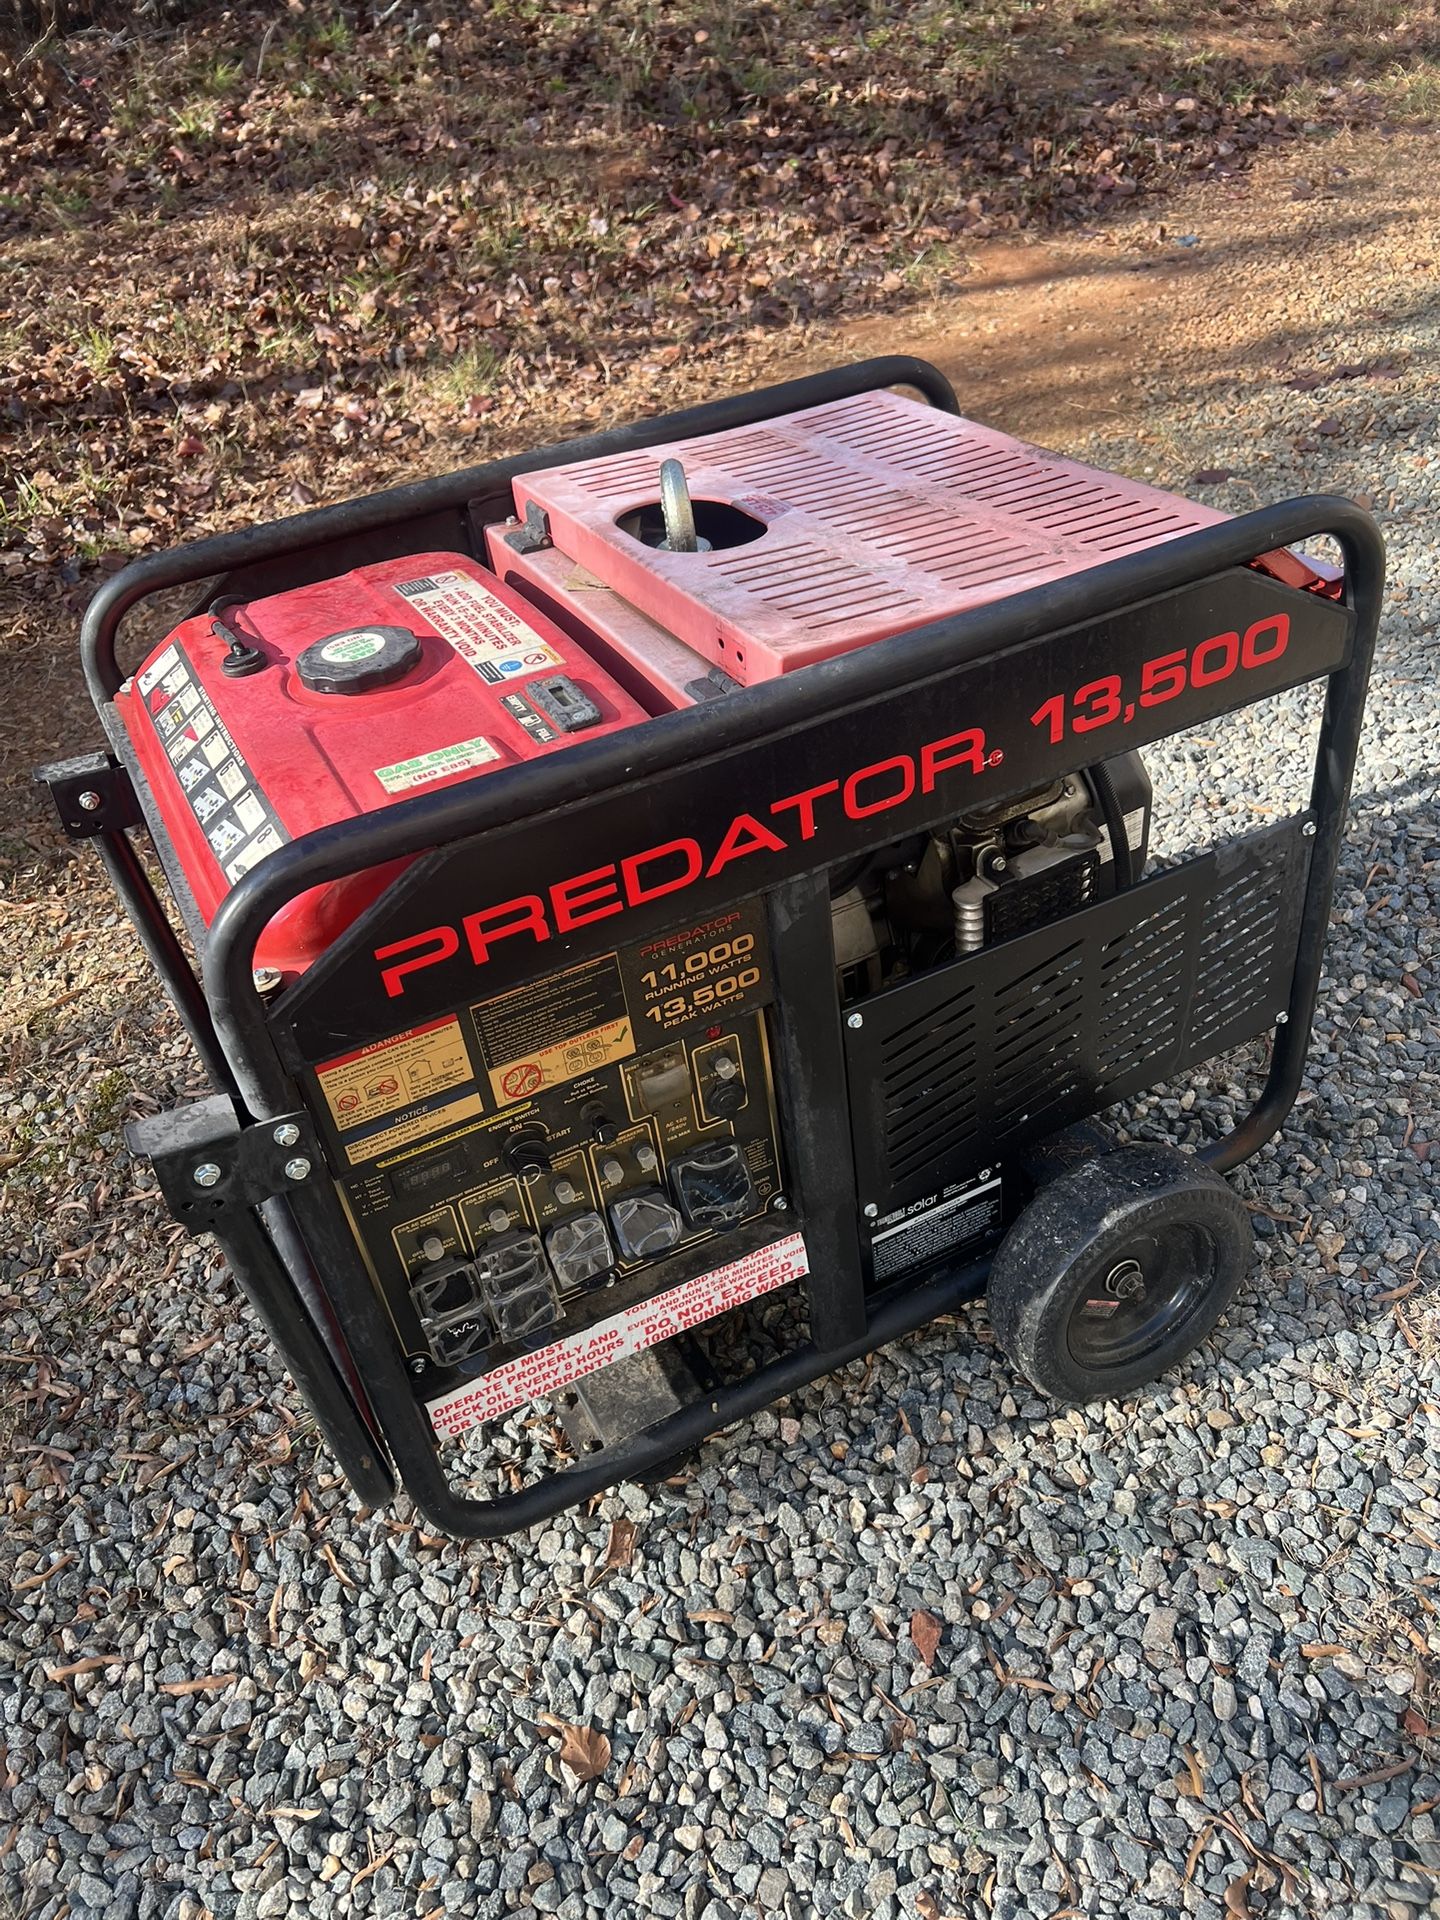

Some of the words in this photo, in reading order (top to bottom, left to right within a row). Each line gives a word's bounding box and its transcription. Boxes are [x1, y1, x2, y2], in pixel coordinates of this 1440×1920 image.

[412, 598, 424, 608] OR
[421, 607, 462, 640] WARRANTY
[457, 637, 477, 657] VOID
[456, 589, 472, 602] ADD
[468, 599, 483, 614] FUEL
[482, 612, 522, 647] STABILIZER
[481, 594, 499, 609] YOU
[499, 605, 521, 627] MUST:
[455, 617, 485, 645] MONTHS
[474, 617, 507, 650] MINUTES
[1030, 613, 1291, 744] 13,500
[198, 685, 217, 716] STARTING
[214, 714, 246, 767] INSTRUCTIONS
[205, 732, 218, 747] 5
[536, 728, 552, 742] FULL
[219, 759, 234, 777] 6
[377, 758, 422, 779] GAS
[427, 738, 483, 762] ONLY
[412, 769, 437, 782] (NO
[441, 758, 472, 774] E85)
[257, 827, 273, 844] 8
[640, 912, 741, 957] PREDATOR
[652, 924, 733, 960] GENERATORS
[641, 933, 754, 988] 11,000
[645, 973, 705, 1001] RUNNING
[708, 953, 752, 976] WATTS
[645, 967, 760, 1022] 13,500
[663, 1011, 698, 1029] PEAK
[702, 992, 744, 1014] WATTS
[368, 1029, 414, 1051] DANGER
[538, 1047, 554, 1057] USE
[554, 1042, 567, 1051] TOP
[569, 1029, 598, 1045] OUTLETS
[599, 1021, 618, 1033] FIRST
[573, 1077, 595, 1089] CHOKE
[347, 1131, 387, 1151] DISCONNECT
[388, 1118, 419, 1134] POWERED
[419, 1107, 446, 1121] DEVICES
[393, 1104, 428, 1124] NOTICE
[488, 1119, 514, 1133] ENGINE
[514, 1107, 540, 1122] SWITCH
[509, 1123, 523, 1133] ON
[349, 1144, 368, 1156] before
[369, 1133, 397, 1148] generator
[398, 1127, 411, 1136] shut
[546, 1127, 572, 1142] START
[483, 1157, 499, 1168] OFF
[486, 1181, 513, 1196] BREAKER
[907, 1195, 938, 1215] solar
[419, 1209, 447, 1223] BREAKER
[543, 1203, 553, 1211] AC
[624, 1301, 647, 1317] YOU
[650, 1285, 681, 1305] MUST
[685, 1273, 708, 1289] ADD
[711, 1260, 738, 1277] FUEL
[626, 1311, 661, 1332] EVERY
[662, 1308, 667, 1316] 3
[669, 1288, 711, 1312] MONTHS
[713, 1281, 727, 1292] OR
[728, 1256, 781, 1285] WARRANTY
[783, 1244, 805, 1260] VOID
[644, 1315, 671, 1335] DO
[676, 1295, 716, 1321] NOT
[720, 1259, 793, 1300] EXCEED
[658, 1295, 680, 1310] AND
[681, 1285, 702, 1300] RUN
[705, 1272, 730, 1289] 15-20
[732, 1252, 774, 1276] MINUTES
[633, 1323, 678, 1352] 11000
[682, 1289, 752, 1329] RUNNING
[755, 1264, 806, 1295] WATTS
[432, 1379, 502, 1419] OPERATE
[506, 1343, 584, 1386] PROPERLY
[587, 1327, 619, 1349] AND
[483, 1362, 516, 1385] YOU
[520, 1339, 565, 1368] MUST
[432, 1400, 483, 1430] CHECK
[485, 1388, 511, 1406] OIL
[513, 1365, 561, 1394] EVERY
[563, 1360, 573, 1371] 8
[575, 1336, 625, 1366] HOURS
[448, 1417, 472, 1435] OR
[474, 1393, 524, 1423] VOIDS
[527, 1352, 614, 1399] WARRANTY
